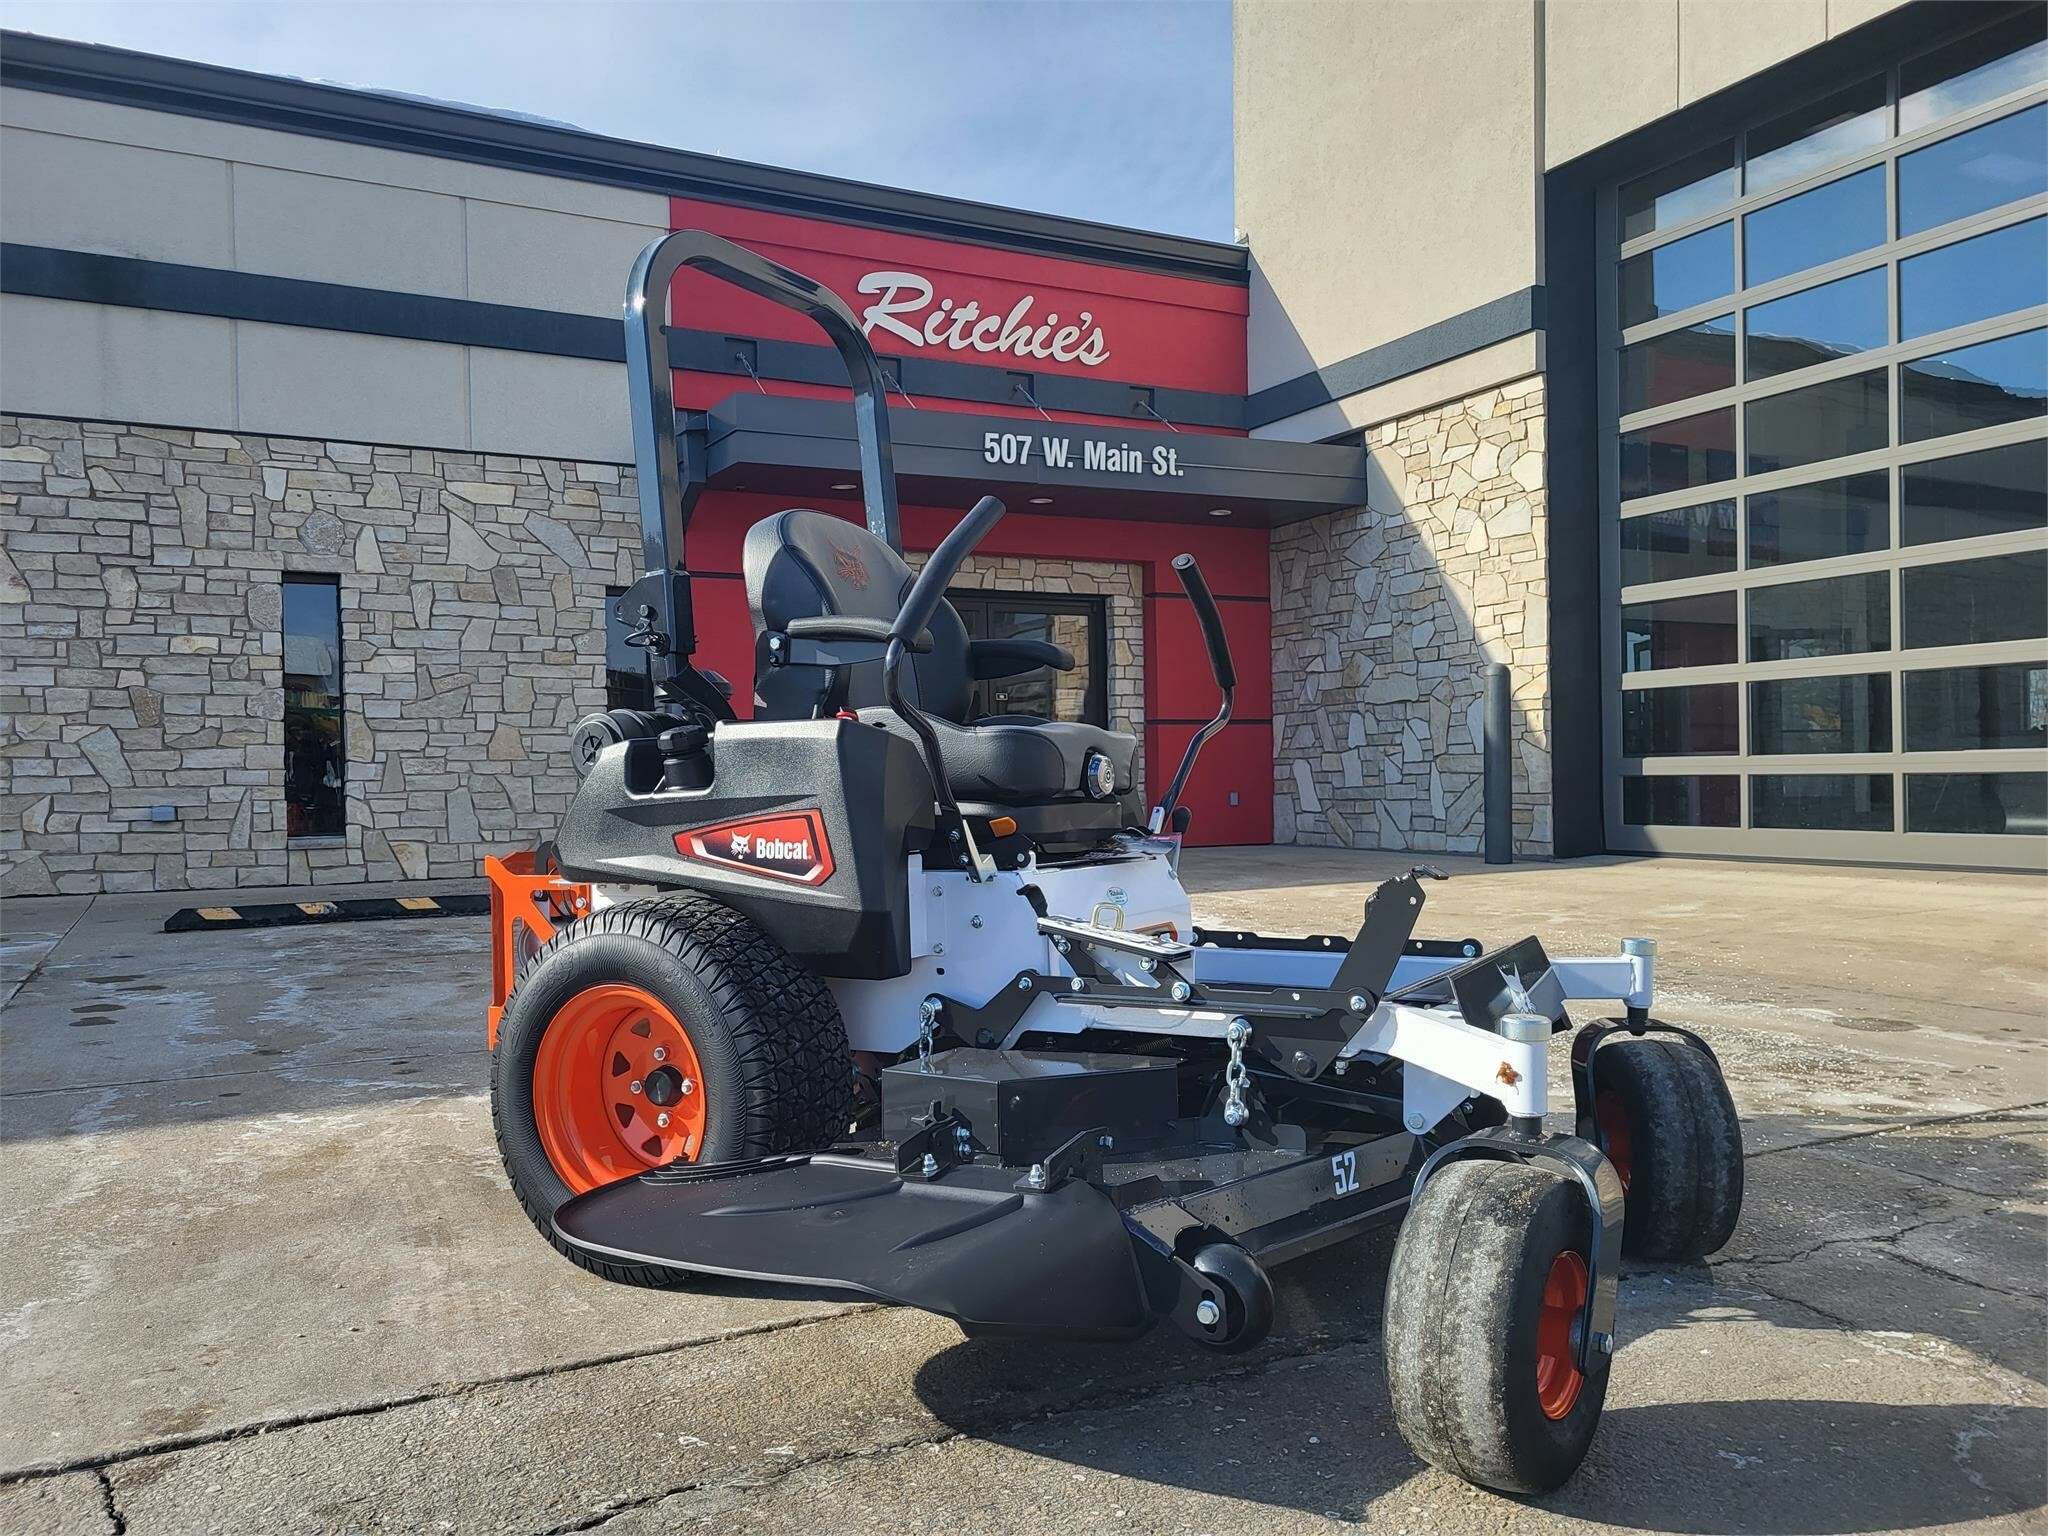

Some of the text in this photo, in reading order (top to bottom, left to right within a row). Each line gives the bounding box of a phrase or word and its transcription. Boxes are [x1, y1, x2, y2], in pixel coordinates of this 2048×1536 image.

[858, 271, 1110, 366] Ritchie's
[983, 432, 1184, 476] 507 W. Main St.
[756, 837, 809, 860] Bobcat
[1331, 1151, 1360, 1195] 52
